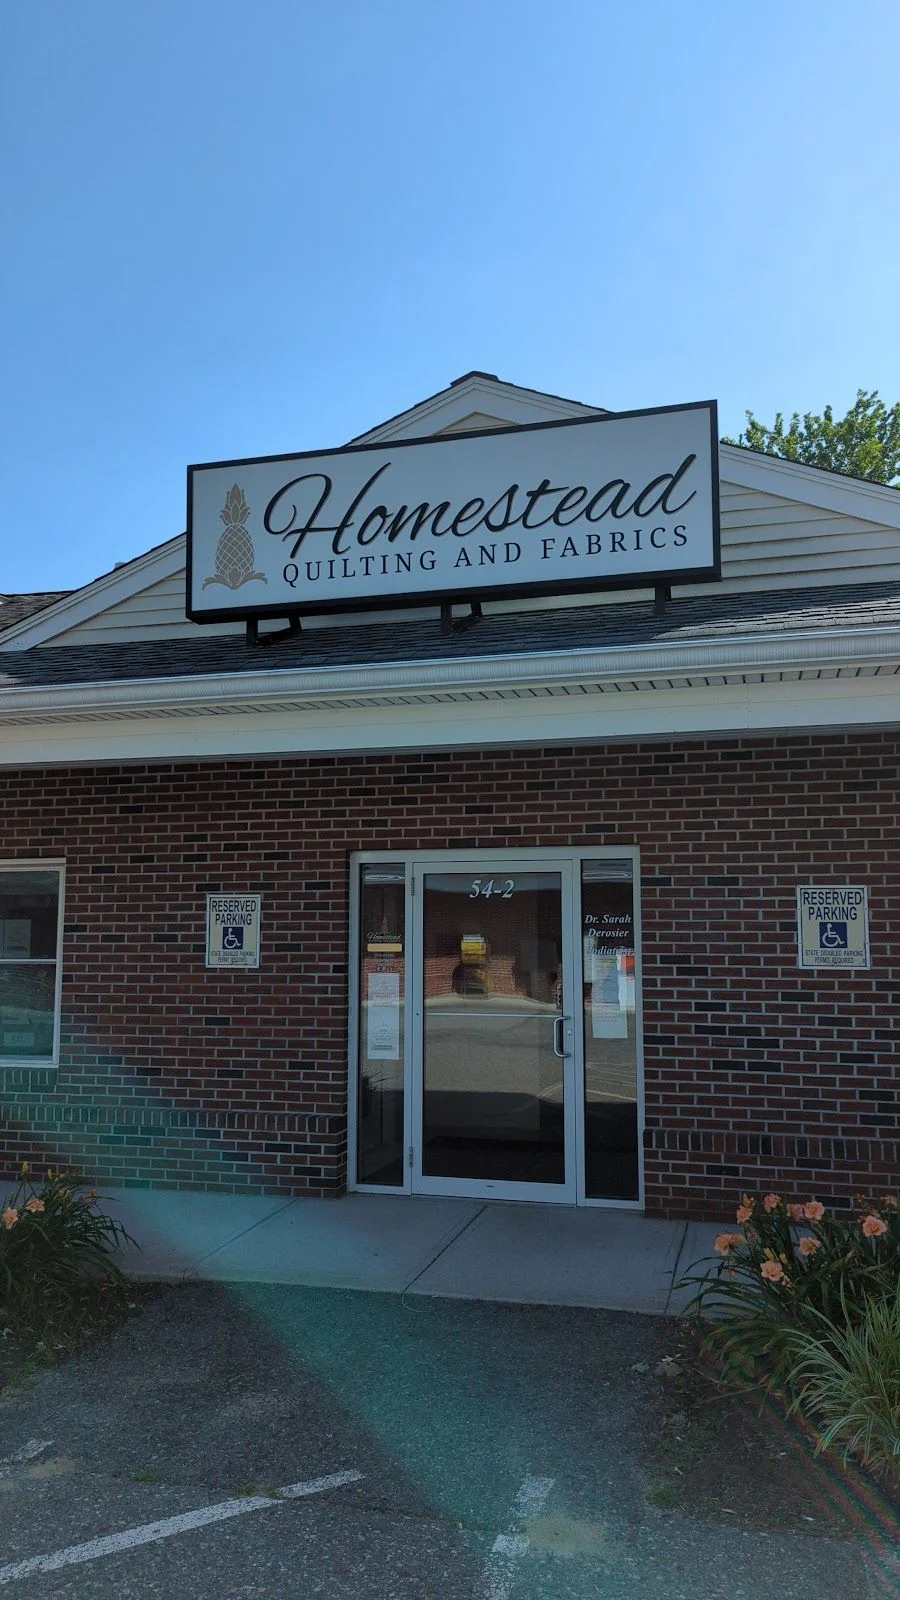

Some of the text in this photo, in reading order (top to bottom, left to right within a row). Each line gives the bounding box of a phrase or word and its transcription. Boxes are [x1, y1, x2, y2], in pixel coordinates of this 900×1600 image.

[263, 453, 697, 559] Homestead
[282, 525, 688, 588] QUILTING AND FABRICS
[469, 878, 516, 899] 54-2
[802, 891, 863, 906] RESERVED
[211, 900, 257, 913] RESERVED
[808, 906, 858, 921] PARKING
[215, 913, 253, 926] PARKING
[584, 914, 631, 924] Dr. Sarah
[588, 928, 629, 938] Derosier
